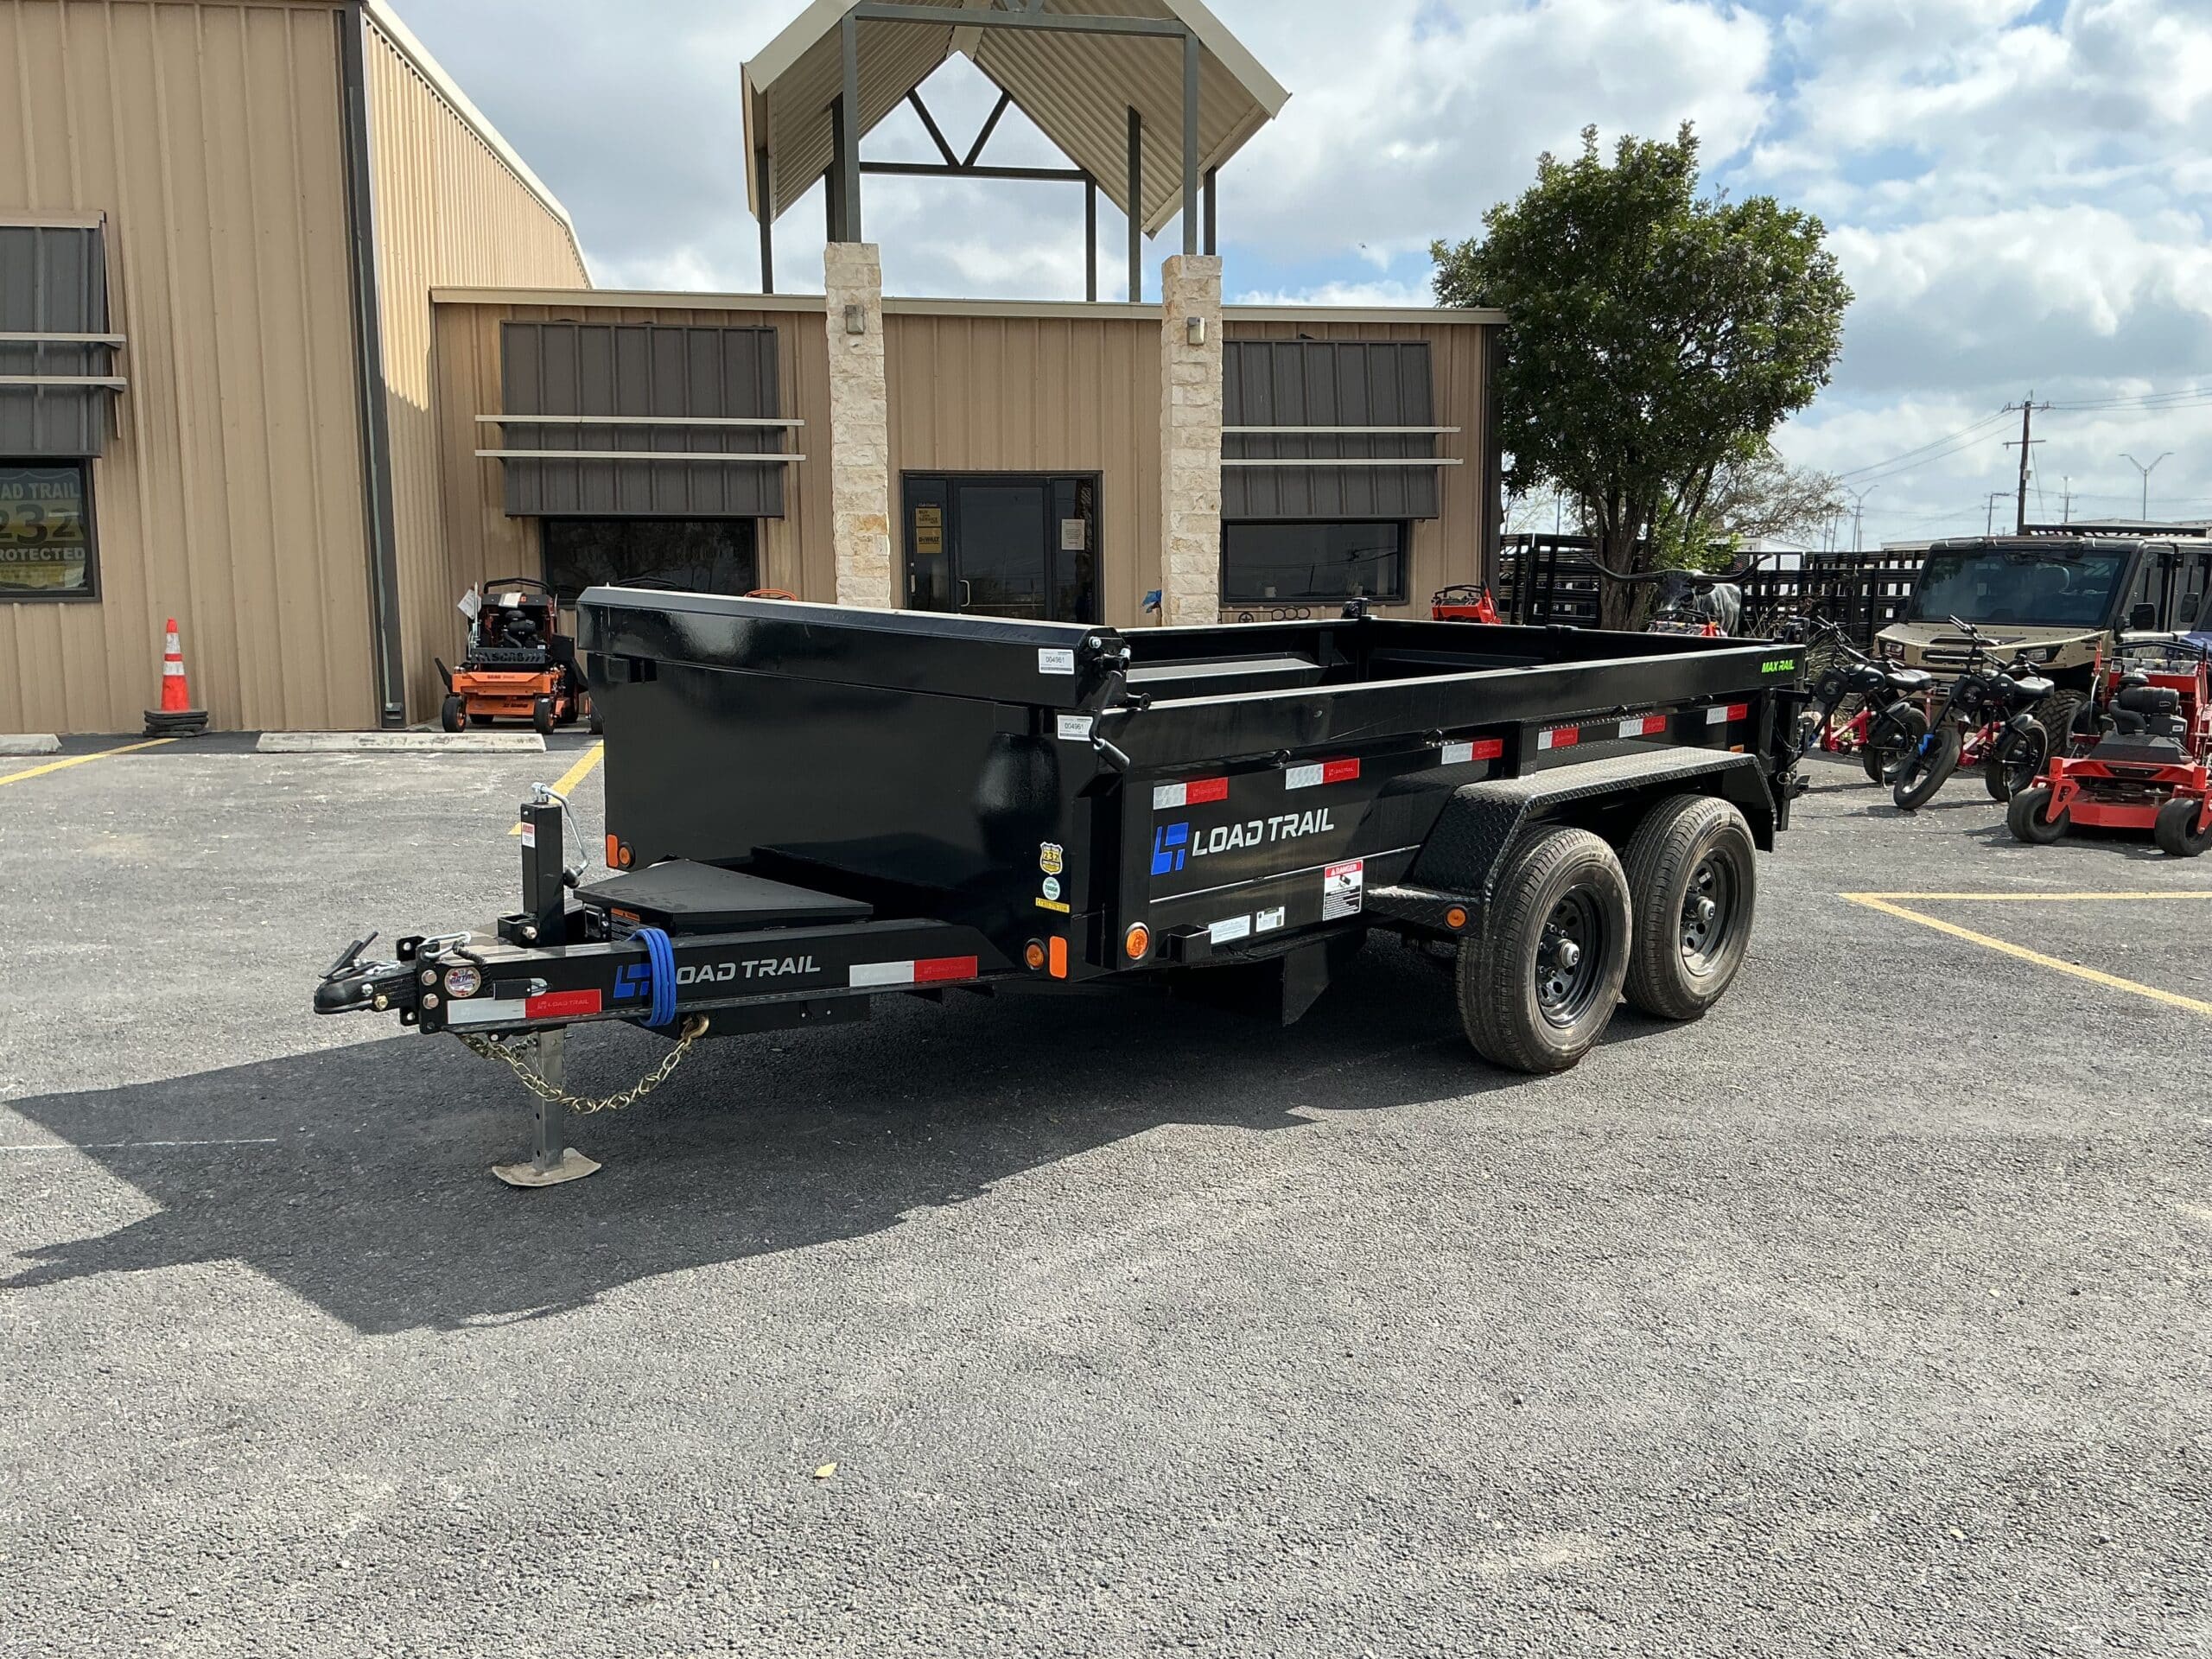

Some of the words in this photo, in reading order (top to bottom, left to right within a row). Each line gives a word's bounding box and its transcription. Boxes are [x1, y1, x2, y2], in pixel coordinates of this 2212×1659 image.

[29, 482, 81, 499] TRAIL
[1762, 661, 1778, 673] MAX
[1778, 659, 1795, 671] RAIL
[1192, 820, 1263, 857] LOAD
[1268, 808, 1335, 842] TRAIL
[1043, 851, 1059, 861] 232
[1335, 863, 1357, 874] DANGER
[676, 963, 736, 985] OAD
[741, 956, 821, 979] TRAIL
